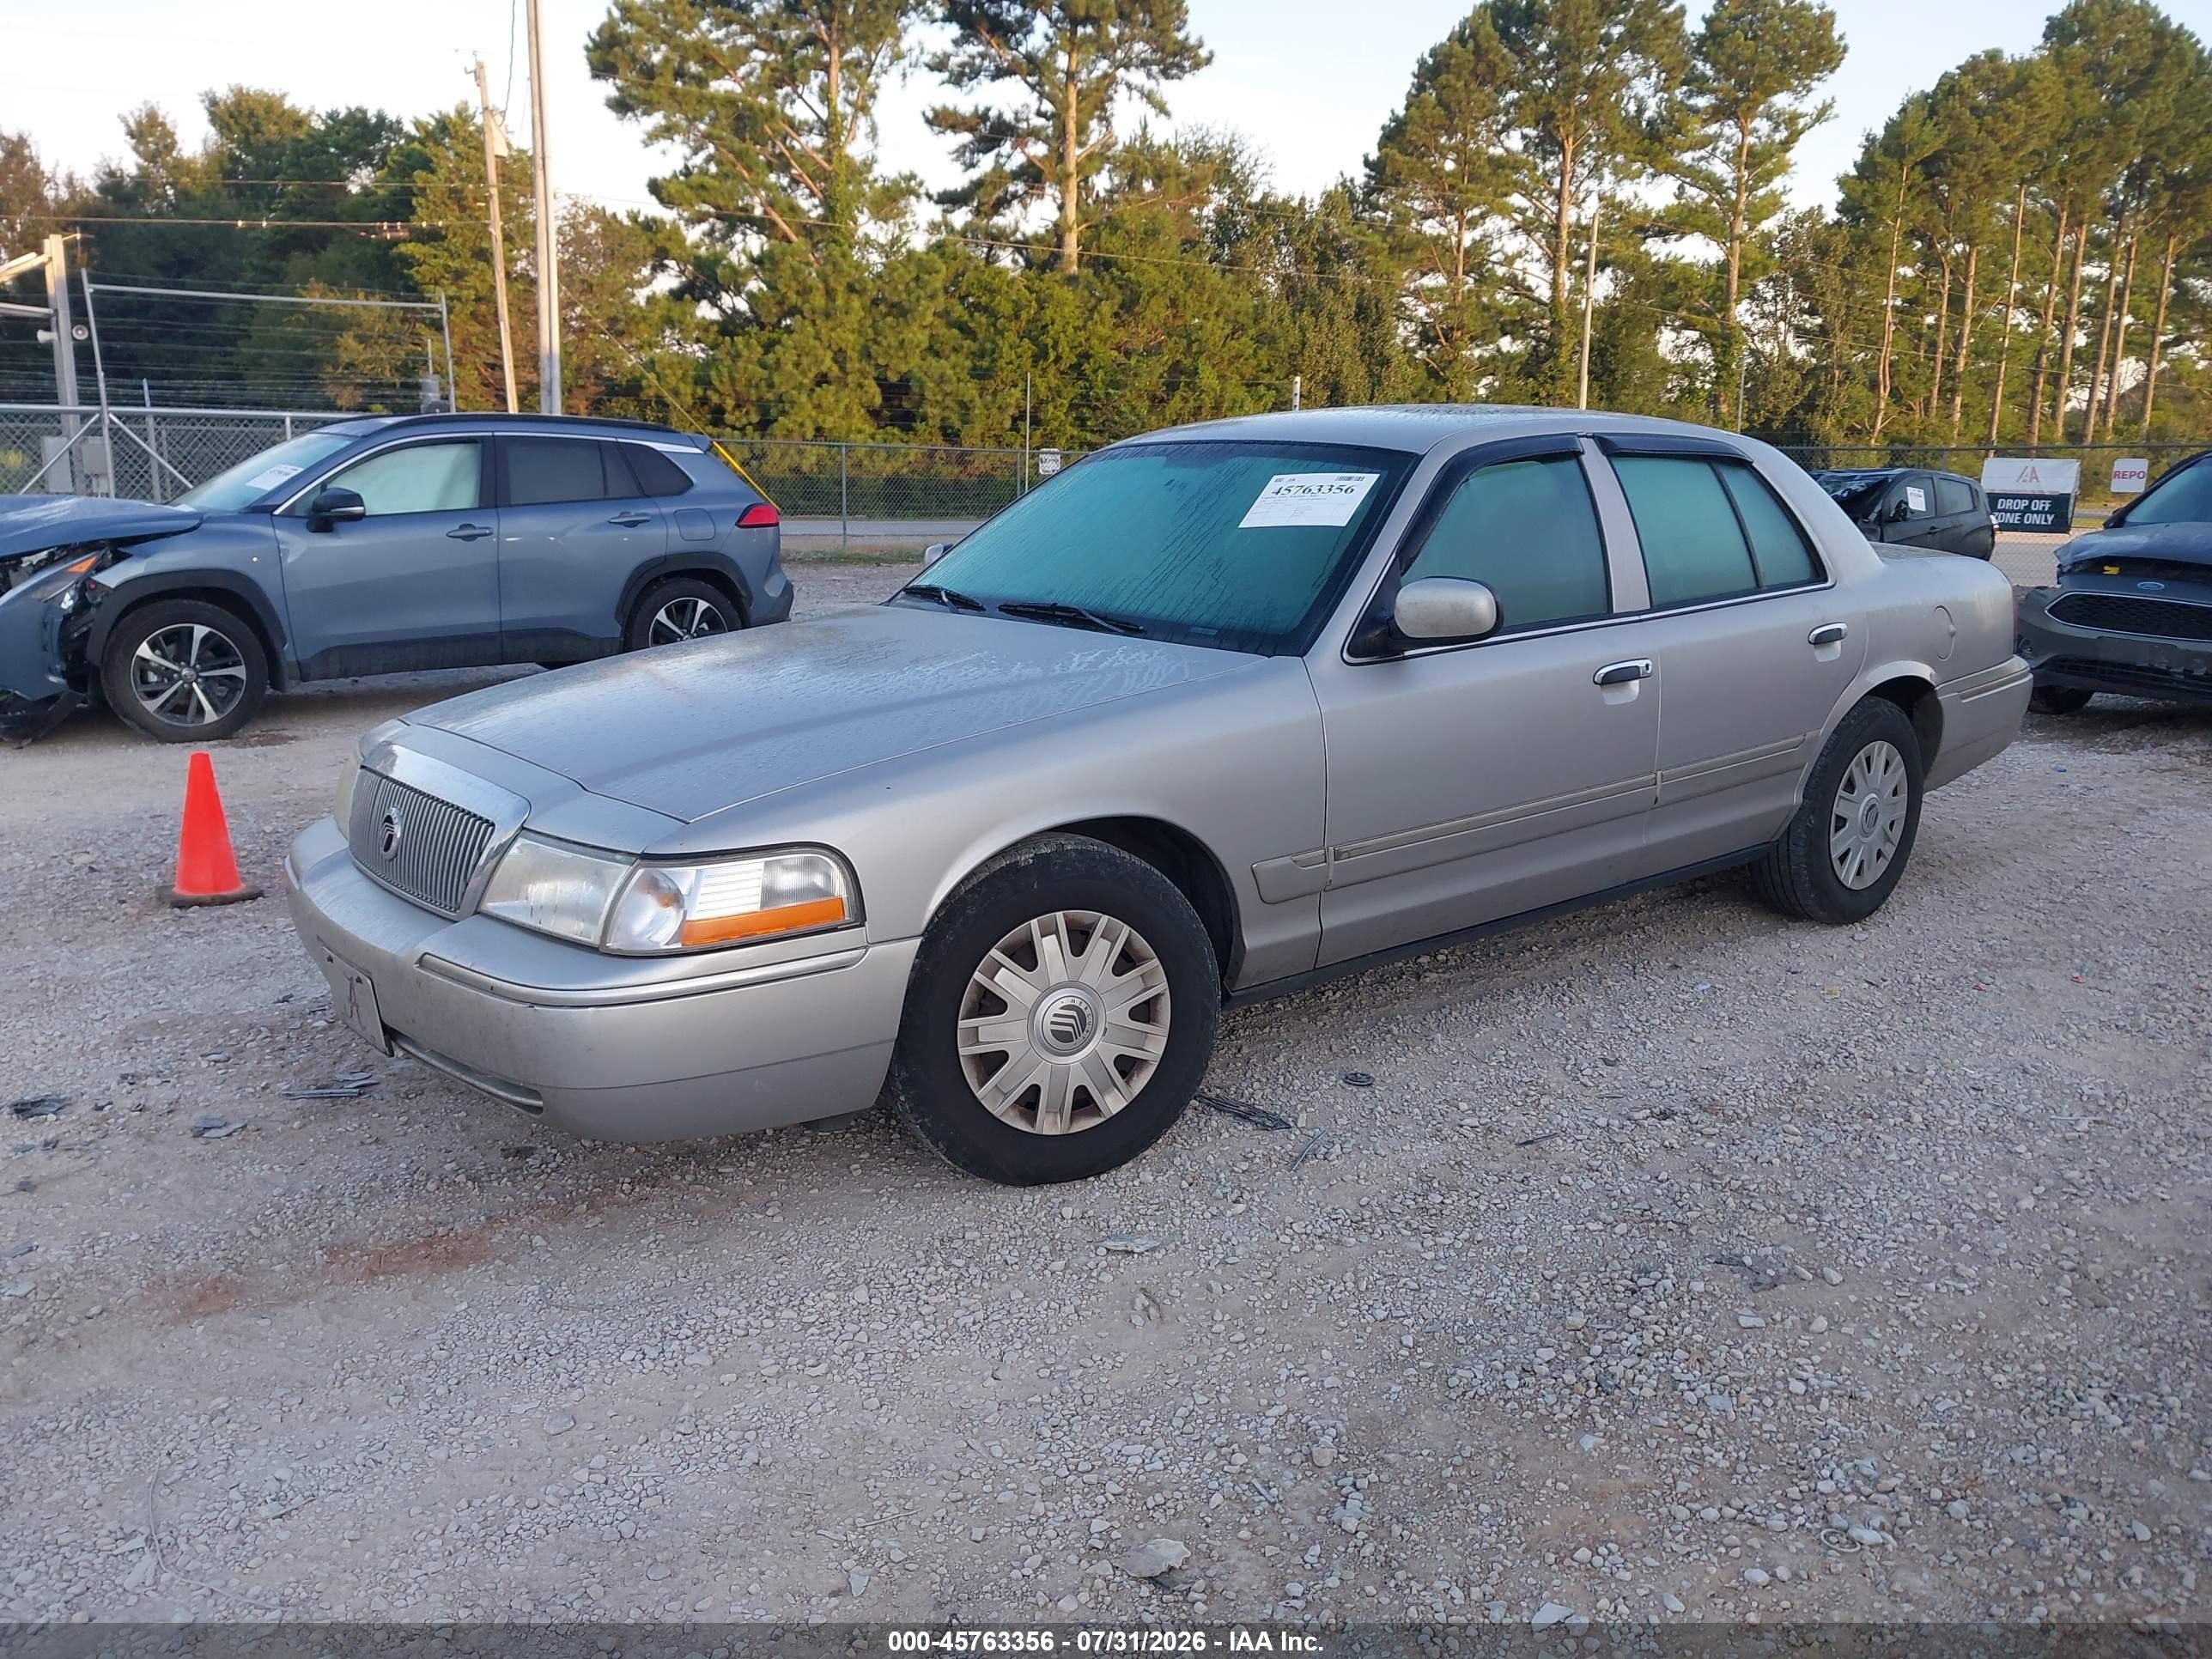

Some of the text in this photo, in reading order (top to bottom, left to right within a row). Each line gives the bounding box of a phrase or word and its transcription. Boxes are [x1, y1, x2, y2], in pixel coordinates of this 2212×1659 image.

[2112, 470, 2145, 480] REPO
[1272, 484, 1357, 495] 45763356
[1997, 498, 2052, 512] DROP OFF
[2023, 513, 2055, 525] ONLY
